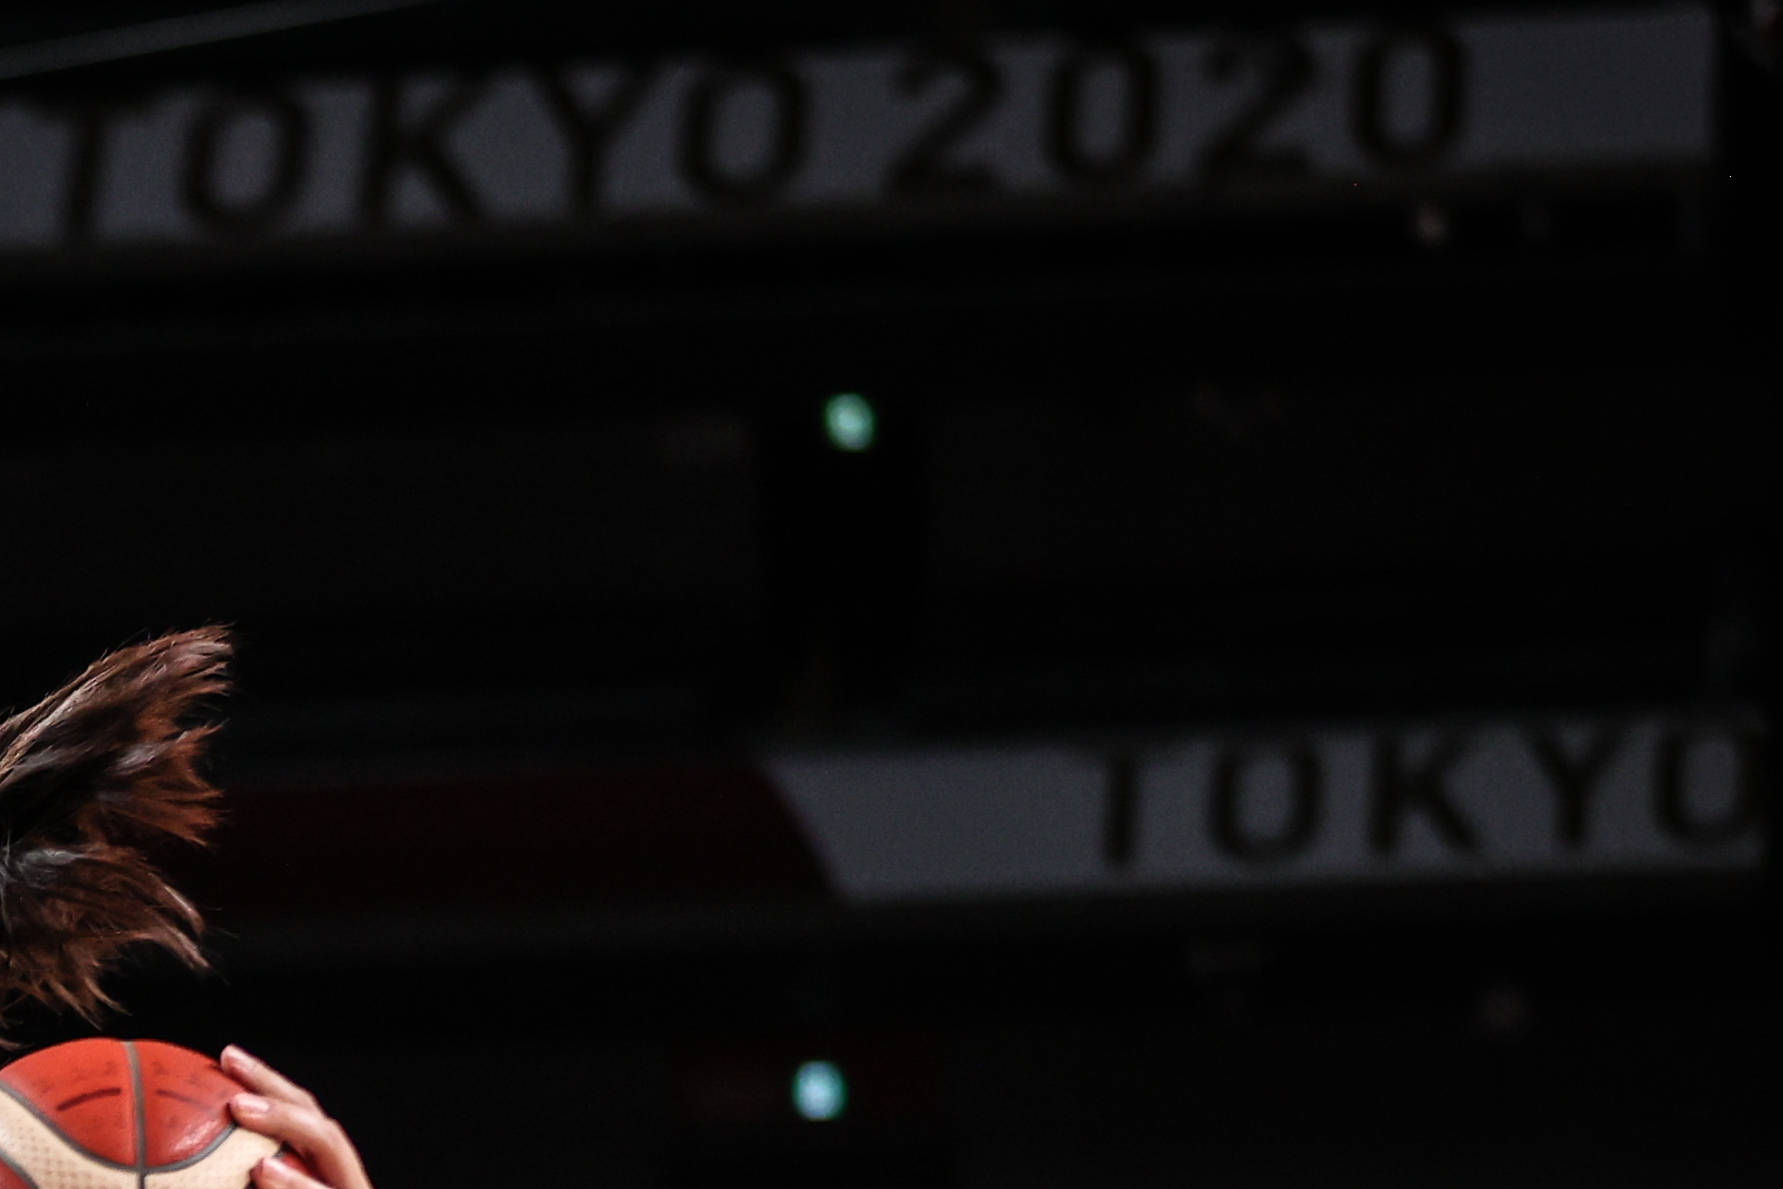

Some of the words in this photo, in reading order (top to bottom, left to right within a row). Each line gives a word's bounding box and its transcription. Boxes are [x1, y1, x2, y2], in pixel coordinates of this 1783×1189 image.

[22, 44, 808, 236] TOKYO
[890, 22, 1464, 190] 2020
[1076, 706, 1772, 866] TOKYO
